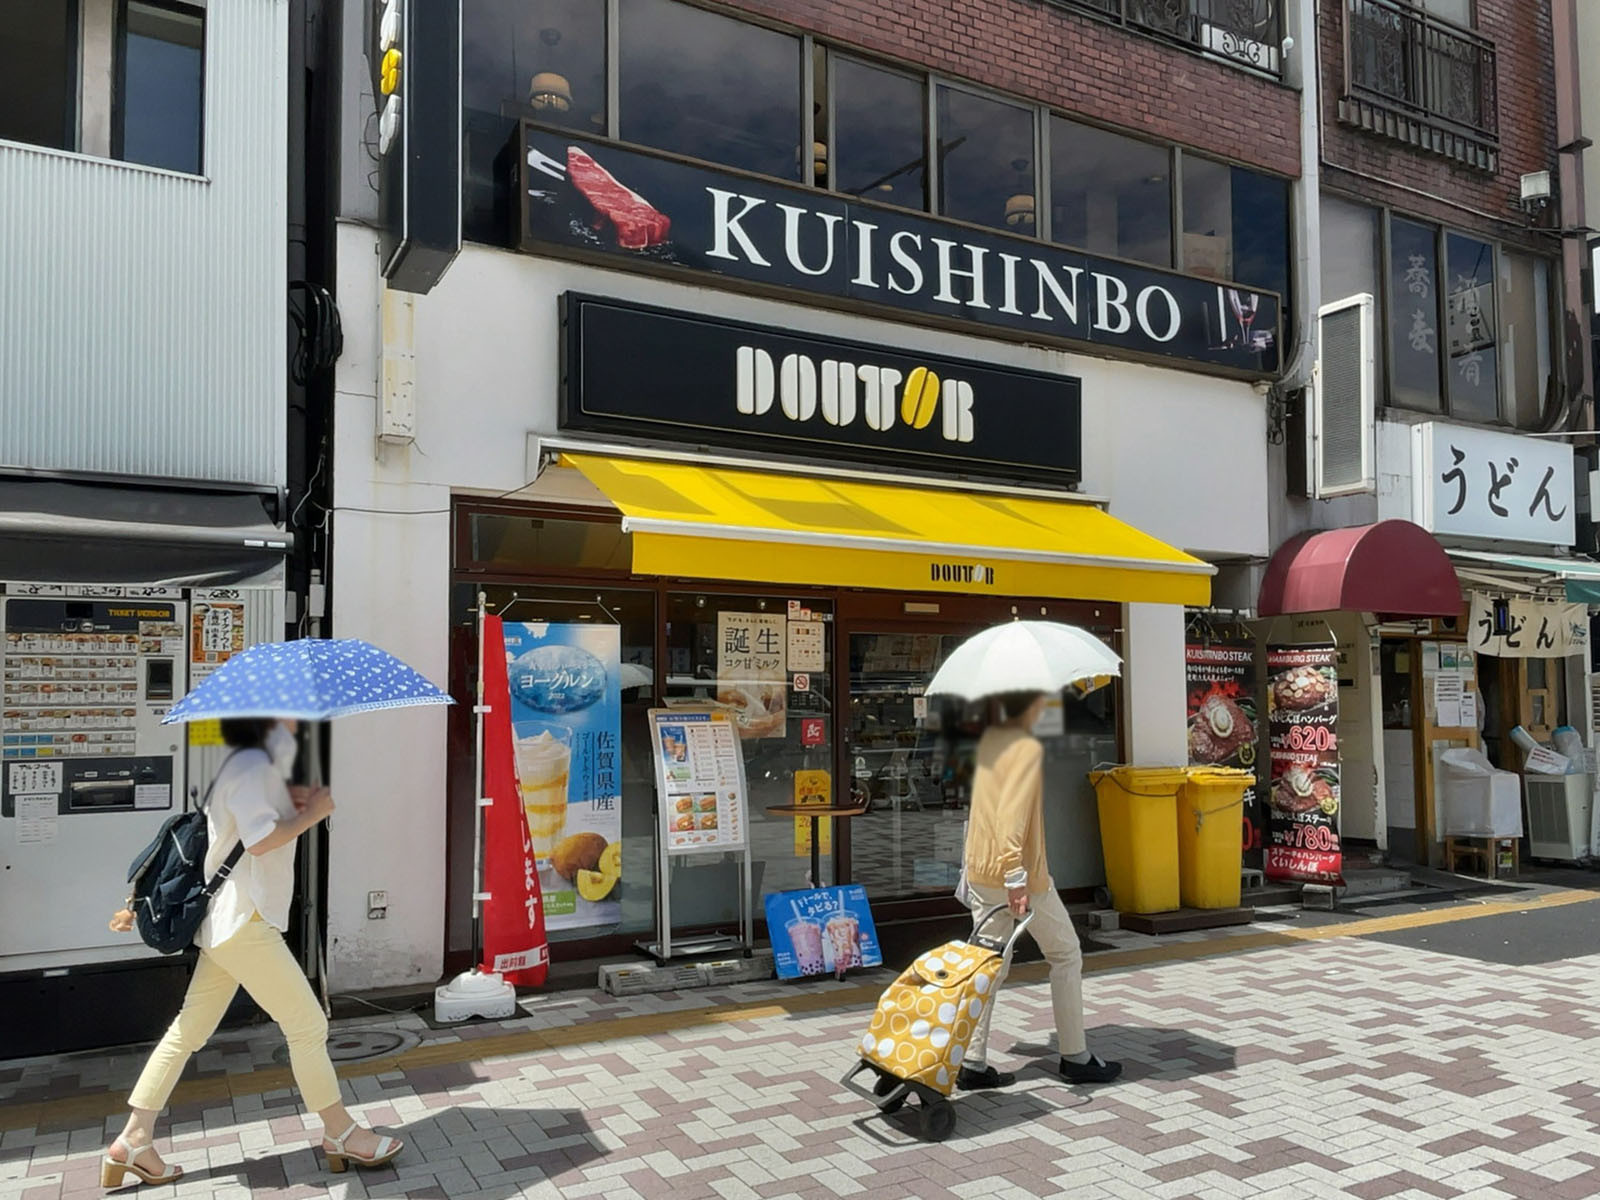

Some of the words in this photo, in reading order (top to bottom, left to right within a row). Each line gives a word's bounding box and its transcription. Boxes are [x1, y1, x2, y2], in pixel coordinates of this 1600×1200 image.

[705, 186, 1181, 343] KUISHINBO
[736, 345, 974, 443] DOUTOR
[1441, 443, 1567, 522] うどん
[930, 563, 995, 585] DOUTOR
[724, 626, 780, 655] 誕生
[1478, 608, 1556, 649] うどん
[1229, 651, 1253, 662] STEAK
[1306, 653, 1331, 663] STEAK
[520, 669, 594, 690] ヨーグルン
[597, 730, 615, 811] 佐賀県産
[1271, 856, 1320, 873] くいしんぼ
